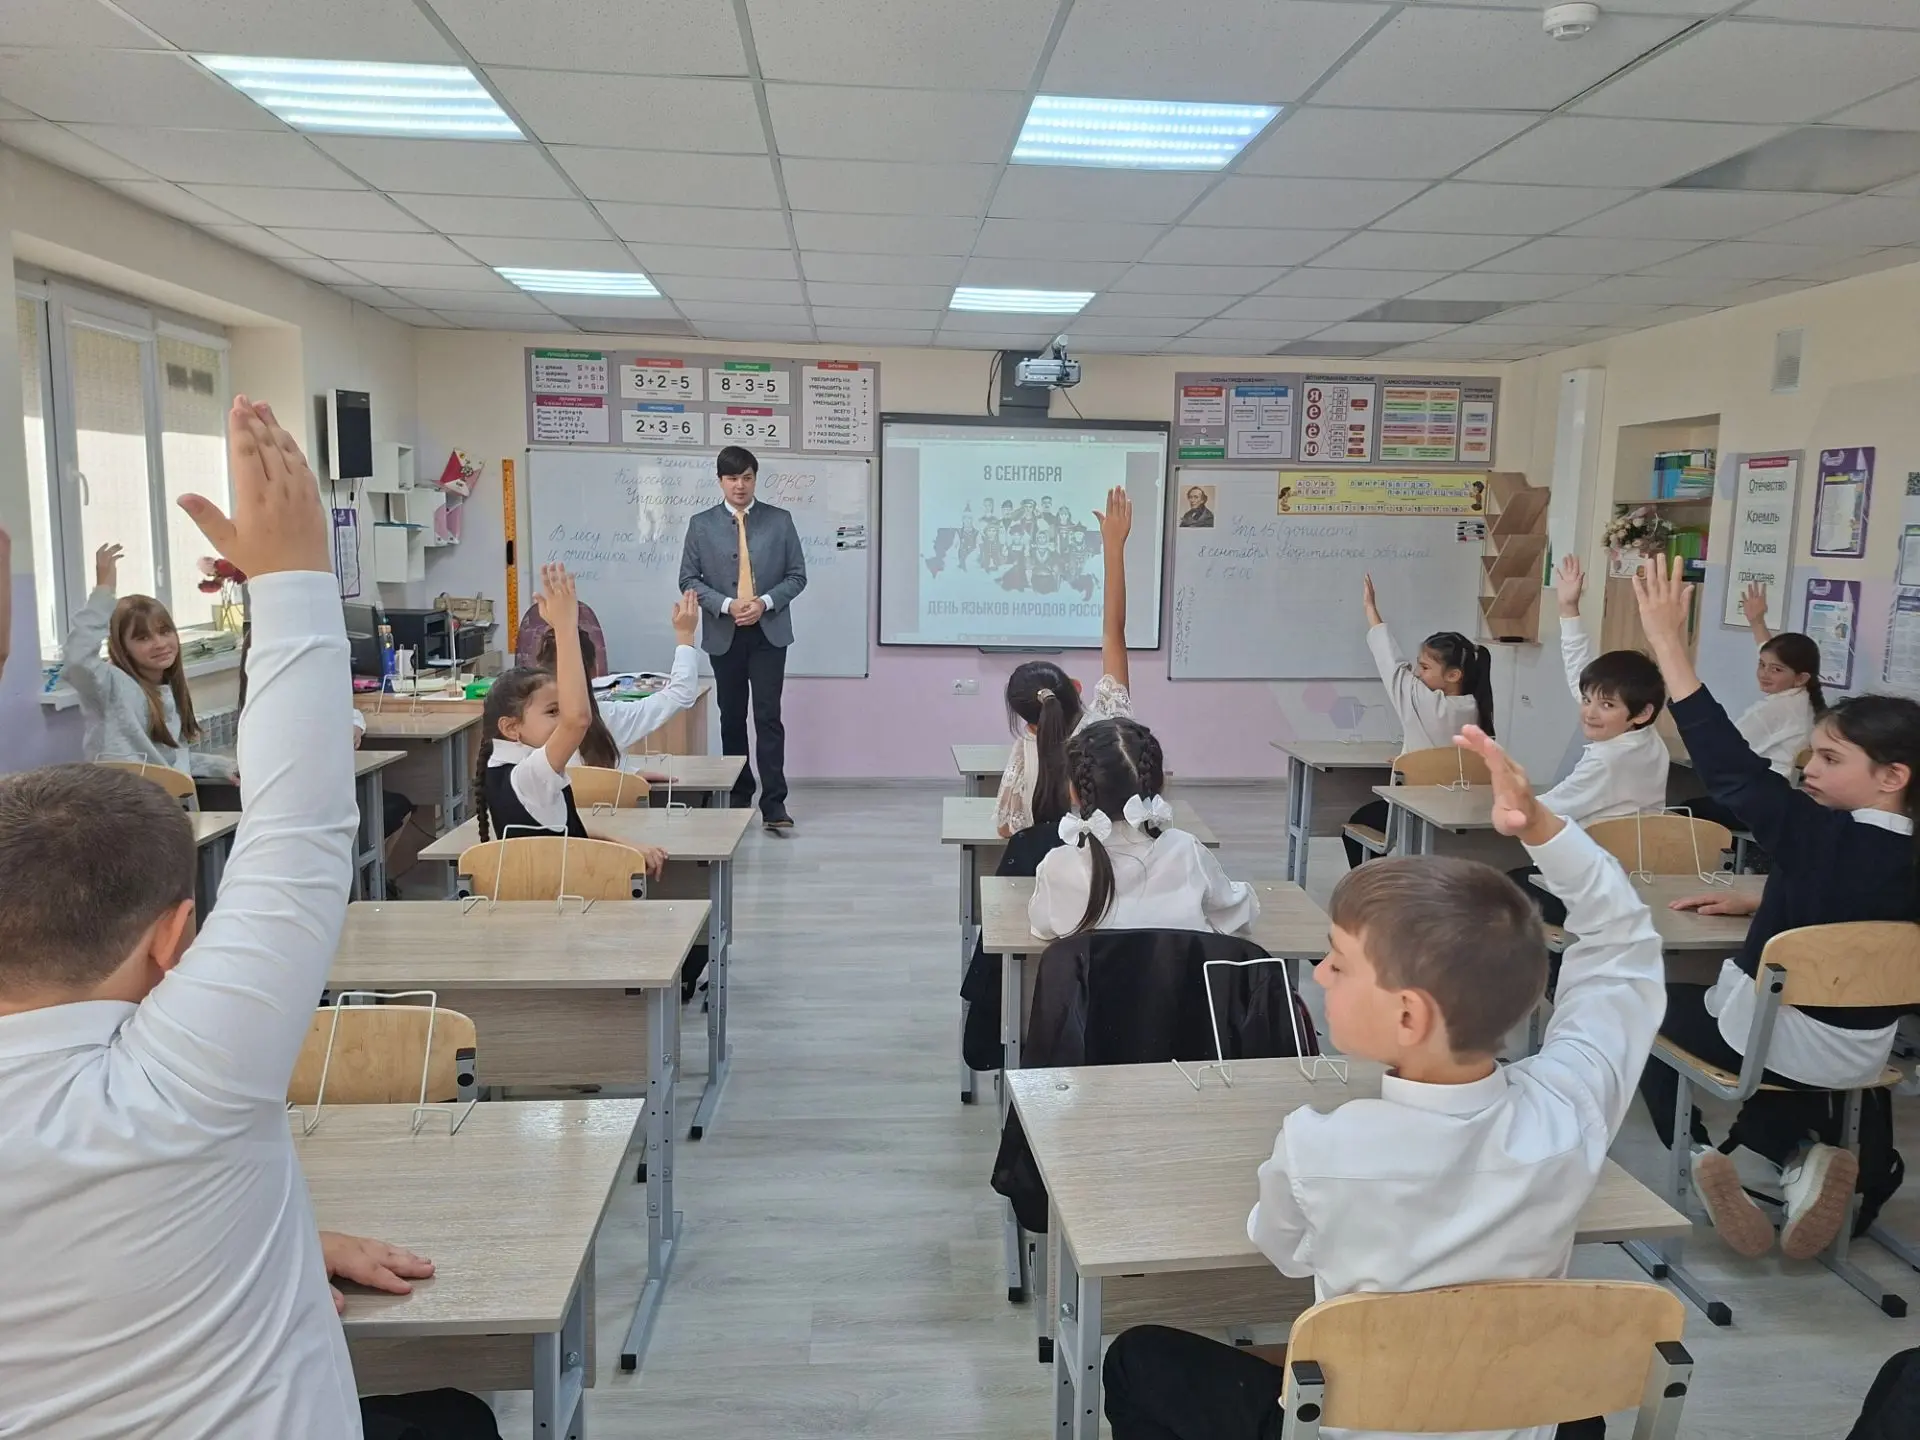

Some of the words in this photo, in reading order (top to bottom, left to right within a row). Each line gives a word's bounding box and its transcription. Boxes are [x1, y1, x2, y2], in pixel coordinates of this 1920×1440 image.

[635, 374, 644, 388] 3
[657, 375, 667, 389] 2
[680, 376, 690, 389] 5
[721, 377, 731, 391] 8
[745, 378, 755, 392] 3
[766, 379, 776, 393] 5
[636, 419, 645, 433] 2
[658, 420, 668, 434] 3
[681, 421, 691, 434] 6
[723, 423, 733, 436] 6
[745, 423, 755, 437] 3
[767, 424, 777, 438] 2
[764, 473, 816, 489] ОРКСЭ
[983, 465, 992, 481] 8
[995, 465, 1063, 482] СЕНТЯБРЯ
[1747, 510, 1780, 523] Кремль
[1260, 521, 1278, 537] 15
[549, 525, 566, 541] В
[570, 531, 601, 549] лесу
[1744, 540, 1777, 554] Москва
[1738, 570, 1775, 584] граждане
[928, 600, 959, 616] ДЕНЬ
[962, 601, 1010, 616] ЯЗЫКОВ
[1012, 602, 1066, 617] НАРОДОВ
[1069, 603, 1104, 617] РОССИ
